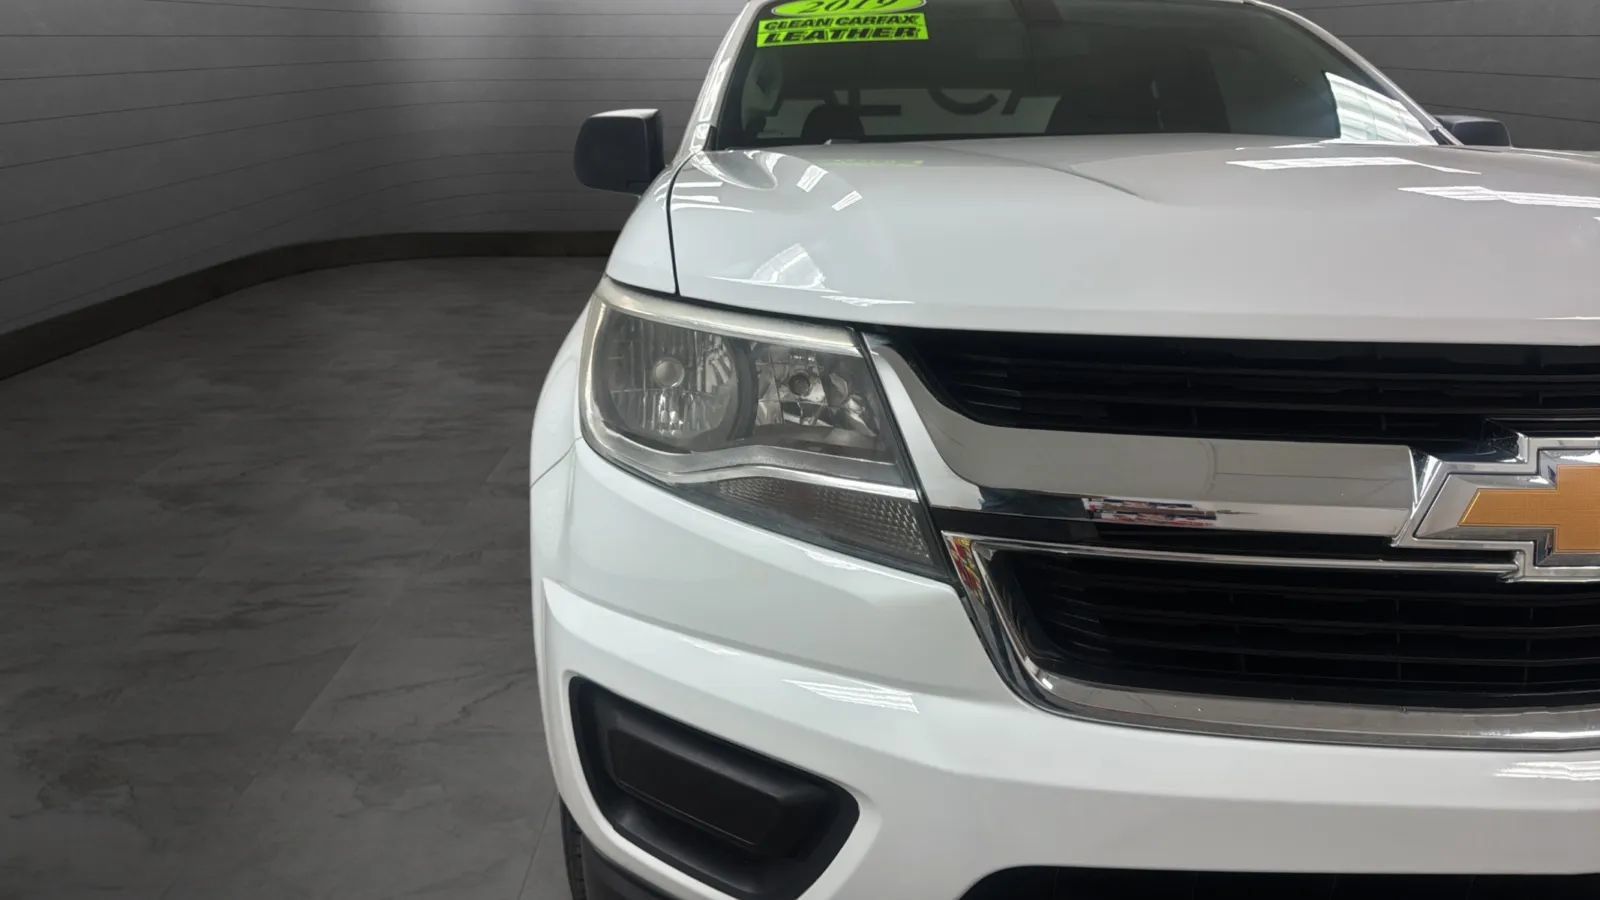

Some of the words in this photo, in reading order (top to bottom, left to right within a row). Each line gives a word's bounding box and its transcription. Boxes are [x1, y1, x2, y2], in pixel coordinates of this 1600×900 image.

[764, 18, 834, 30] CLEAN
[835, 14, 919, 27] CARFAX
[763, 27, 919, 44] LEATHER
